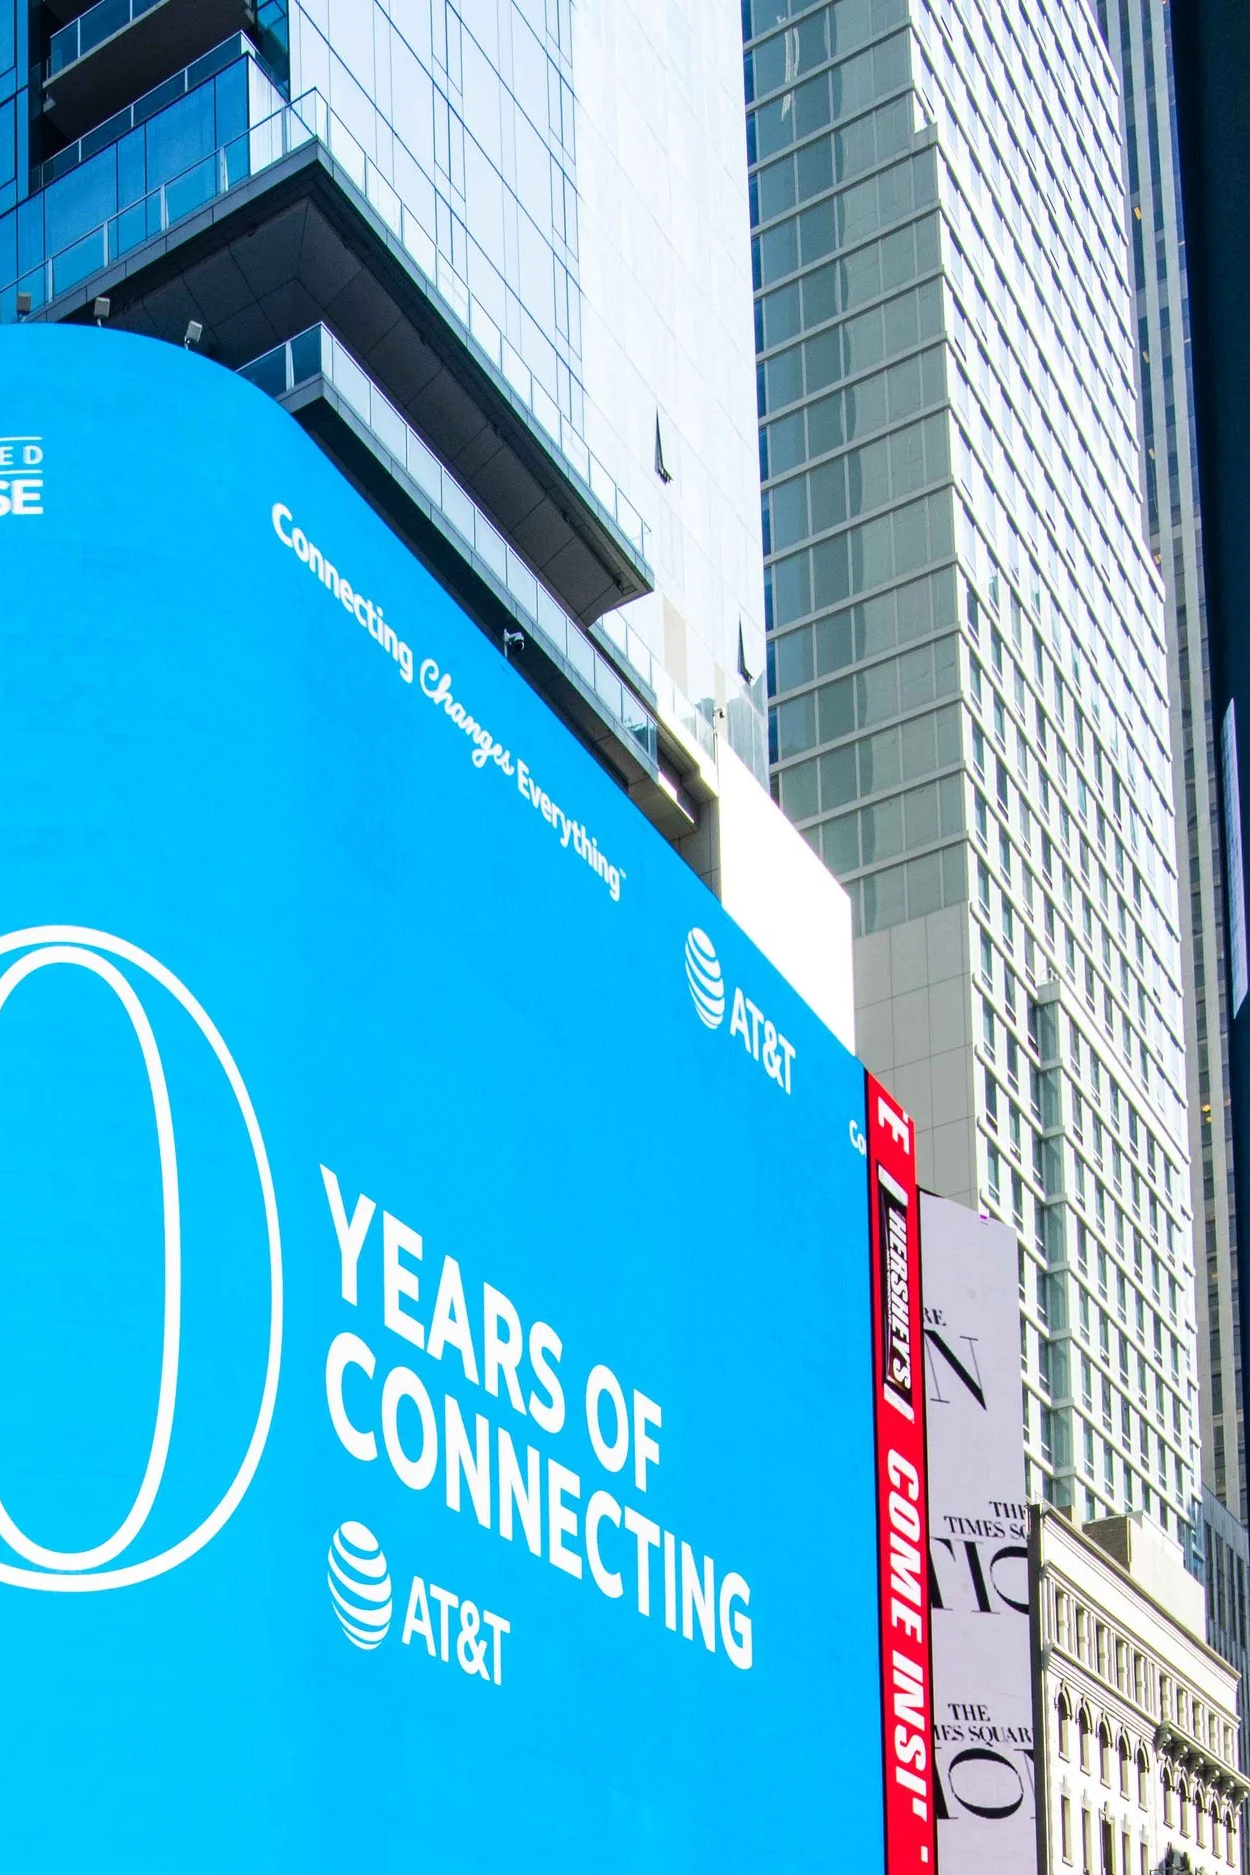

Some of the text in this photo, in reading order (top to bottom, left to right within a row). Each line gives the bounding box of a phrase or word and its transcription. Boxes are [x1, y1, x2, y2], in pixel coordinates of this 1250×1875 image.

[272, 502, 414, 684] Connecting
[419, 659, 515, 777] Changes
[729, 985, 796, 1096] AT&T
[849, 1119, 867, 1158] Co
[319, 1163, 663, 1494] YEARS OF
[887, 1206, 912, 1390] HERSHEY'S
[325, 1331, 754, 1671] CONNECTING
[886, 1448, 923, 1645] COME
[943, 1515, 1006, 1539] TIMES
[402, 1574, 511, 1687] AT&T
[948, 1702, 991, 1723] THE
[967, 1725, 1033, 1748] SQUAR
